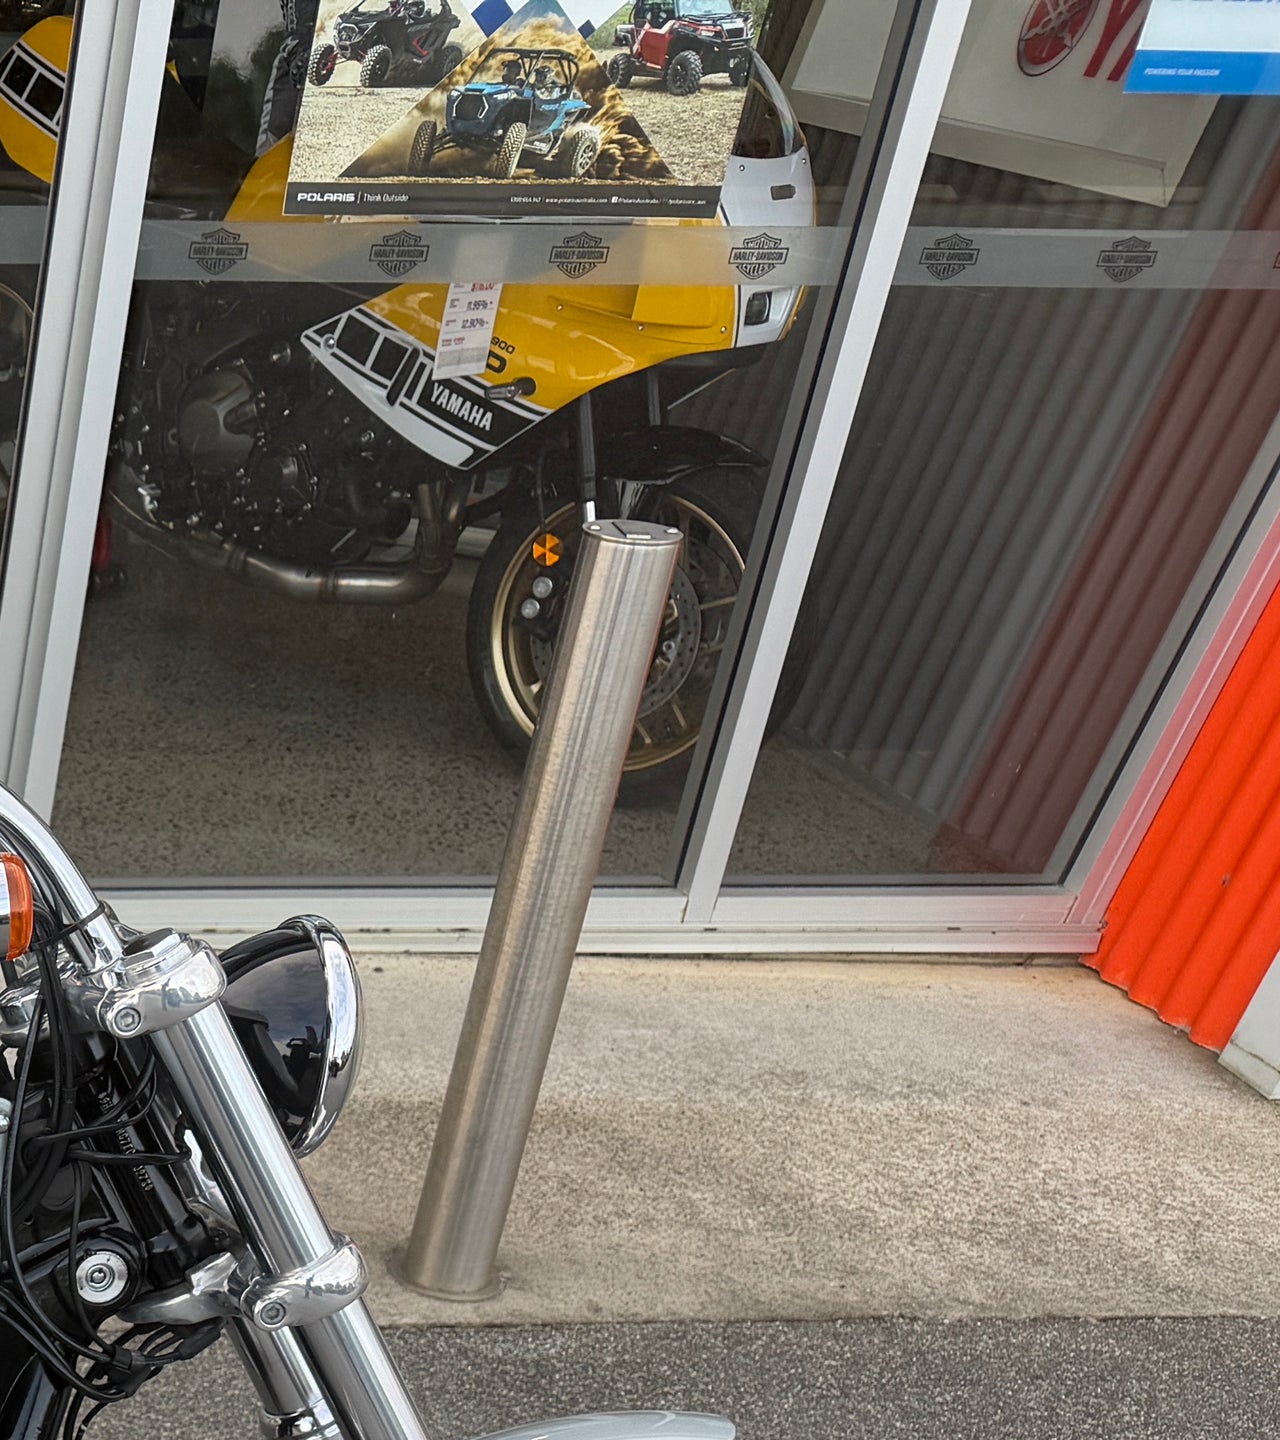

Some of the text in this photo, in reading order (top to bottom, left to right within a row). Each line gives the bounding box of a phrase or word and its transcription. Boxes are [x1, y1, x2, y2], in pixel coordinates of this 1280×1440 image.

[297, 193, 409, 202] POLARIS Think Outside
[431, 382, 493, 431] YAMAHA
